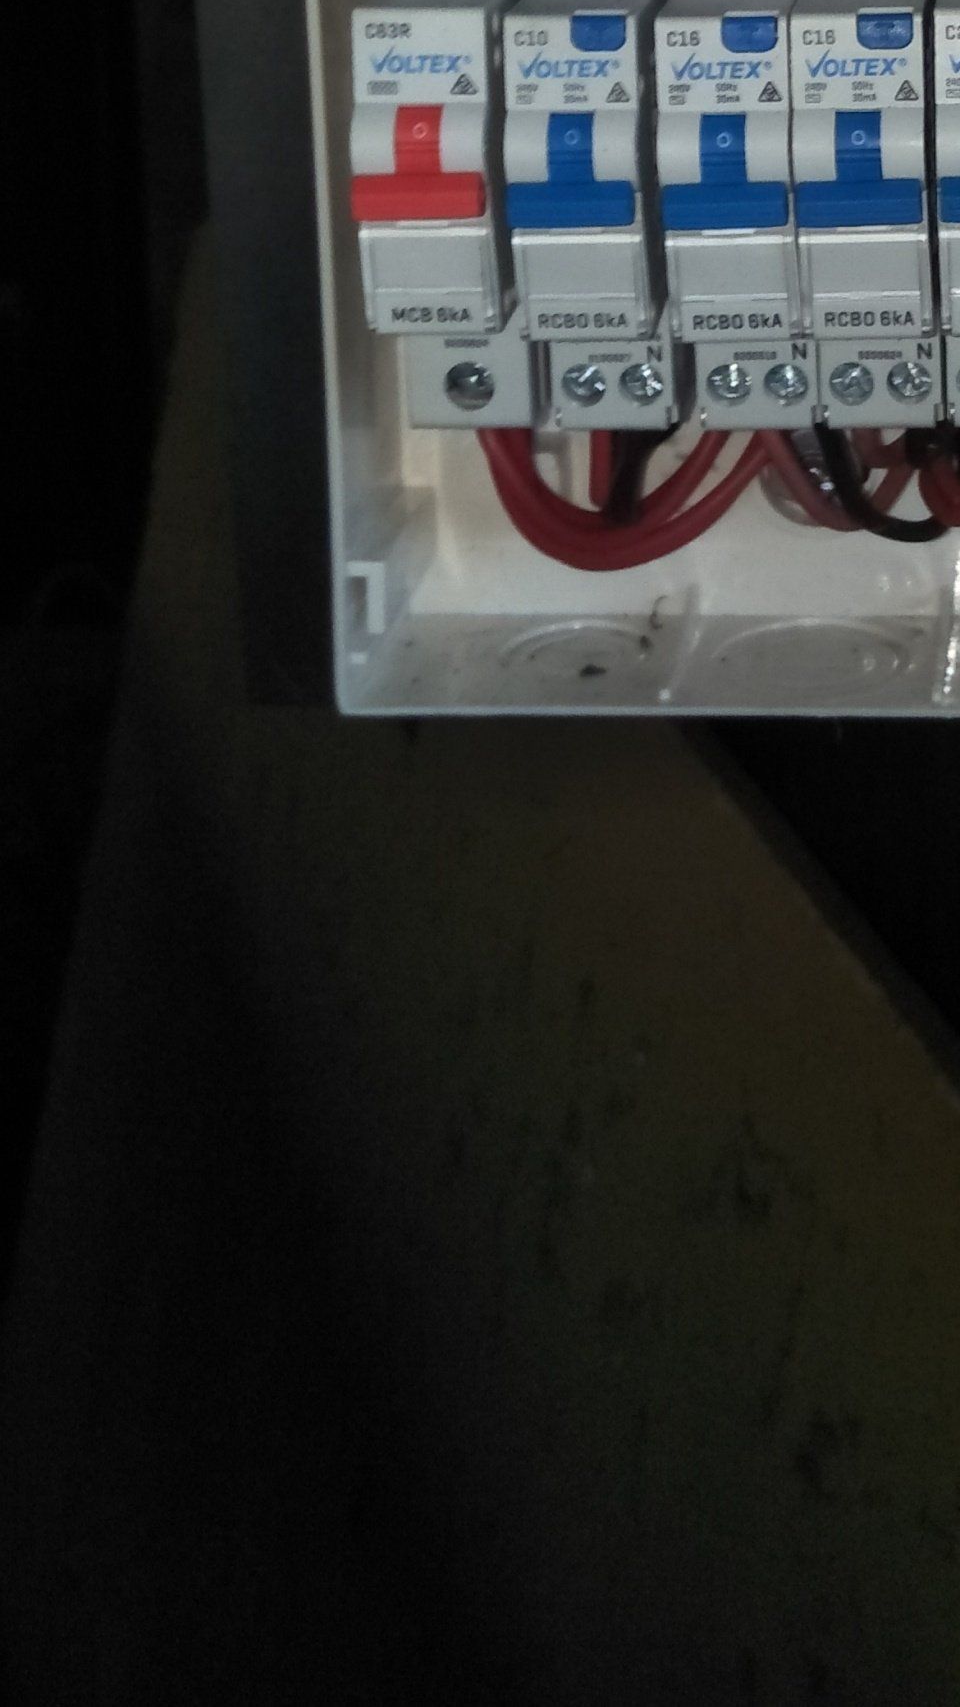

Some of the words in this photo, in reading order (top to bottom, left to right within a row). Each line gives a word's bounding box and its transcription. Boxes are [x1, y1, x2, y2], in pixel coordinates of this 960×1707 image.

[391, 307, 434, 323] MCB
[538, 313, 590, 329] RCBO
[692, 314, 744, 330] RCBO
[824, 311, 876, 327] RCBO
[646, 345, 663, 363] N
[791, 342, 807, 360] N
[917, 342, 933, 360] N
